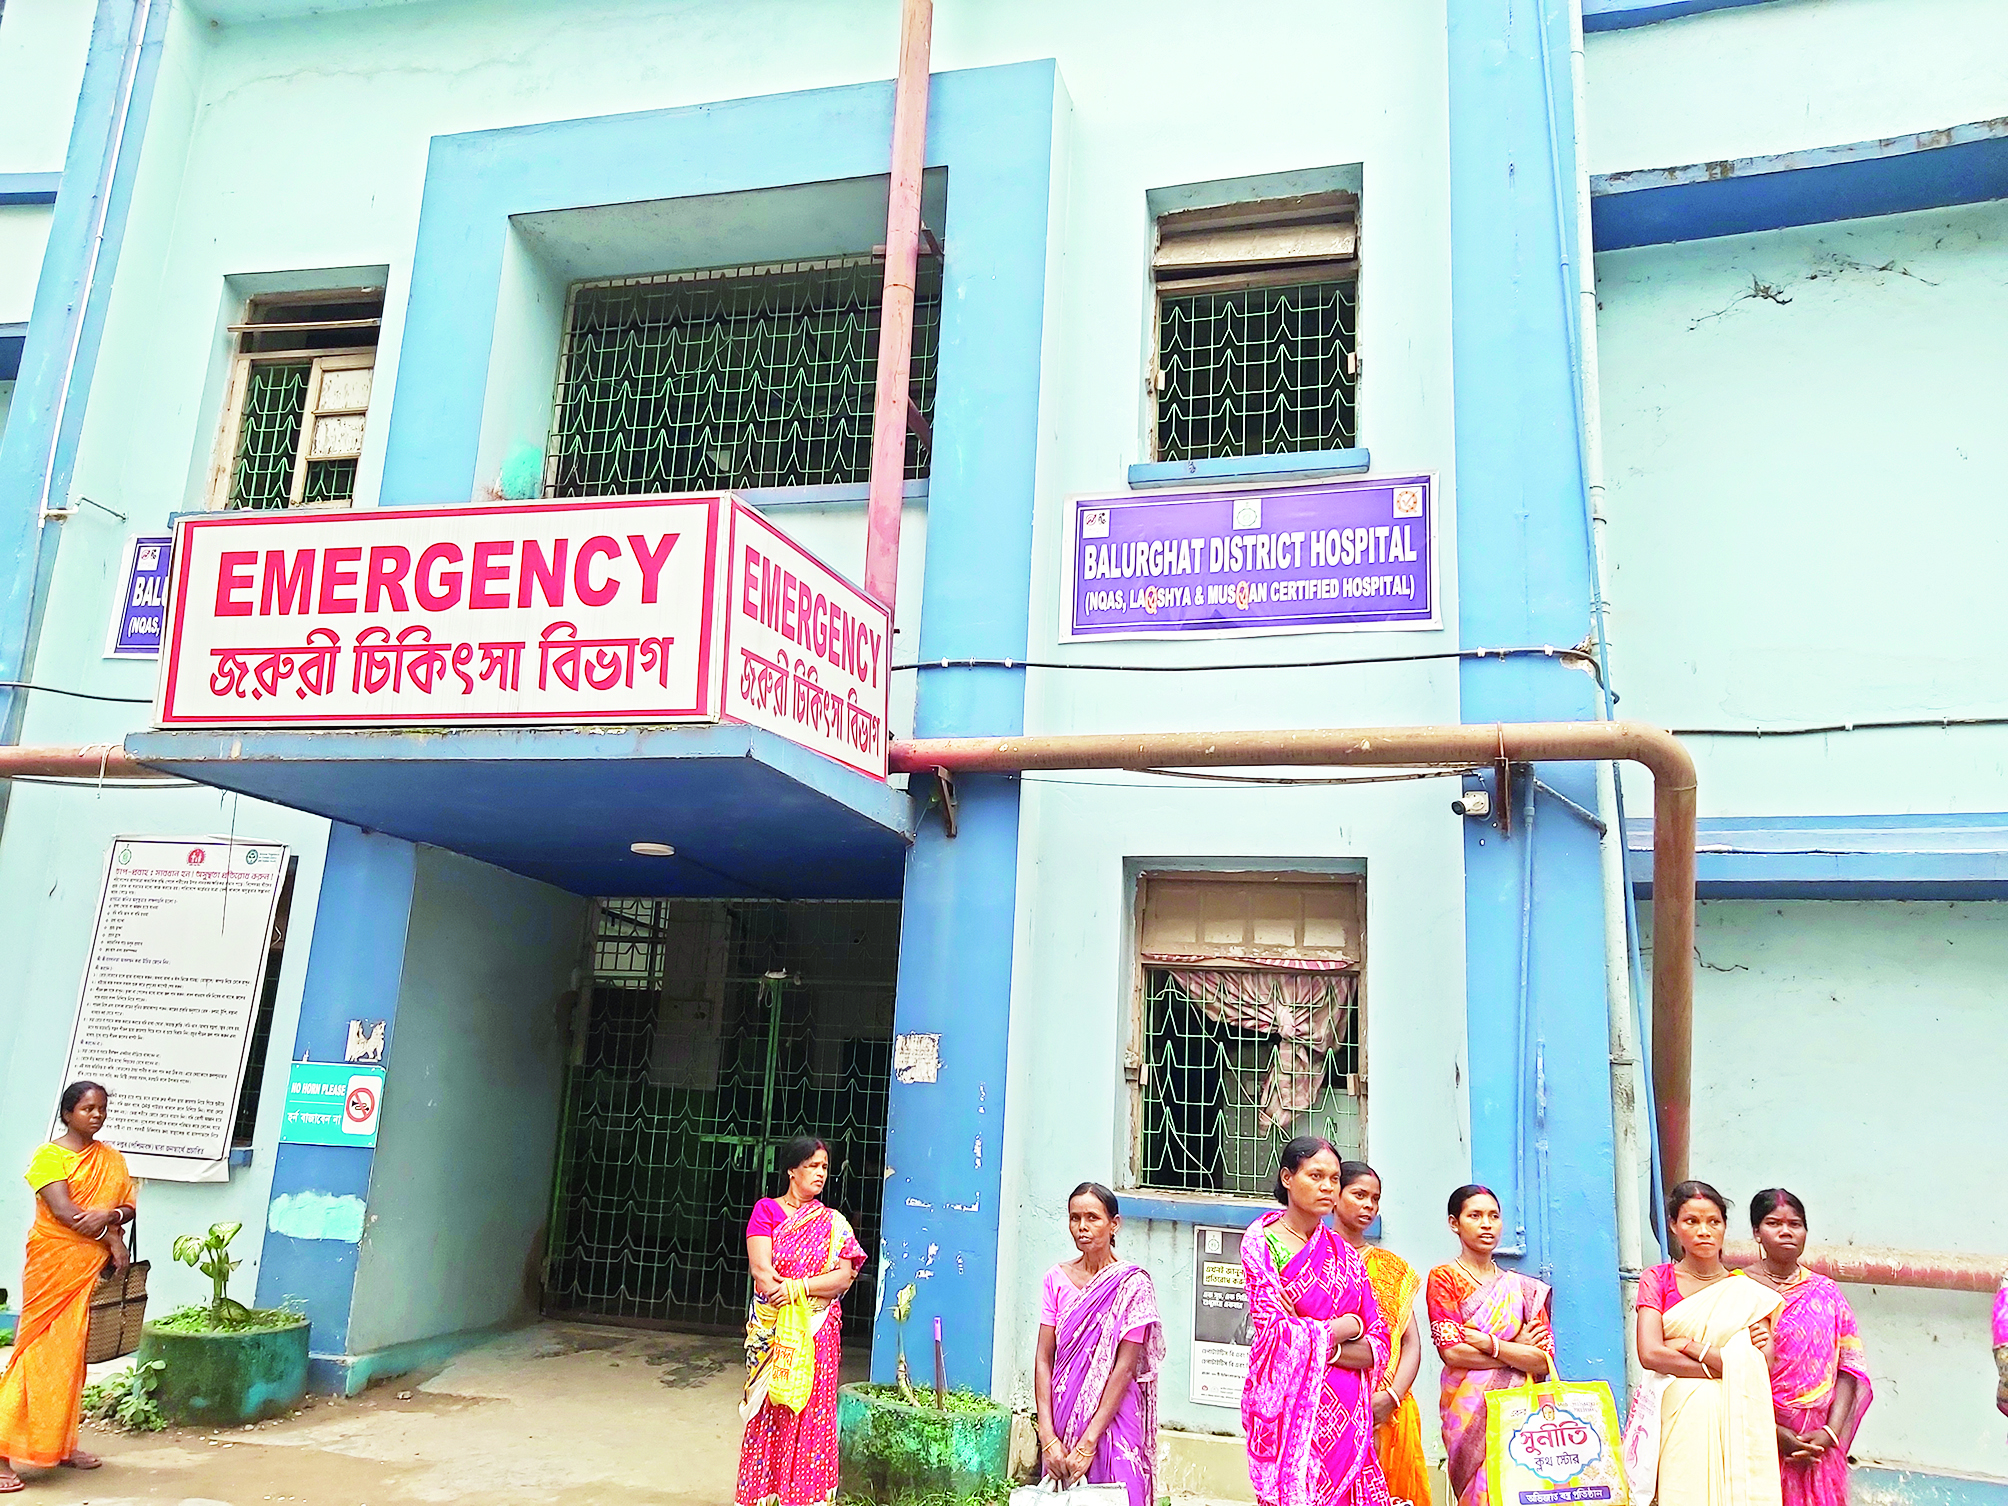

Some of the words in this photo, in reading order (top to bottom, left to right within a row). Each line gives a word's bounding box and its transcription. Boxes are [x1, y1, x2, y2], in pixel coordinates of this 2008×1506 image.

[214, 533, 680, 616] EMERGENCY
[1083, 536, 1204, 580] BALURGHAT
[1209, 530, 1305, 574] DISTRICT
[1310, 524, 1417, 568] HOSPITAL
[743, 544, 881, 689] EMERGENCY
[1084, 589, 1127, 616] (NQAS,
[1194, 586, 1204, 605] &
[1271, 579, 1339, 602] CERTIFIED
[1342, 574, 1415, 601] HOSPITAL)
[210, 628, 341, 700] জরুরী
[352, 625, 525, 695] চিকিৎসা
[538, 621, 674, 692] বিভাগ
[740, 647, 789, 718] জরুরী
[793, 659, 844, 741] চিকিৎসা
[847, 687, 880, 757] বিভাগ
[291, 1082, 301, 1094] NO
[302, 1083, 320, 1095] HORN
[321, 1084, 346, 1096] PLEASE
[332, 1115, 341, 1125] না
[1520, 1421, 1588, 1455] সুনীতি
[1556, 1451, 1579, 1466] স্টোর
